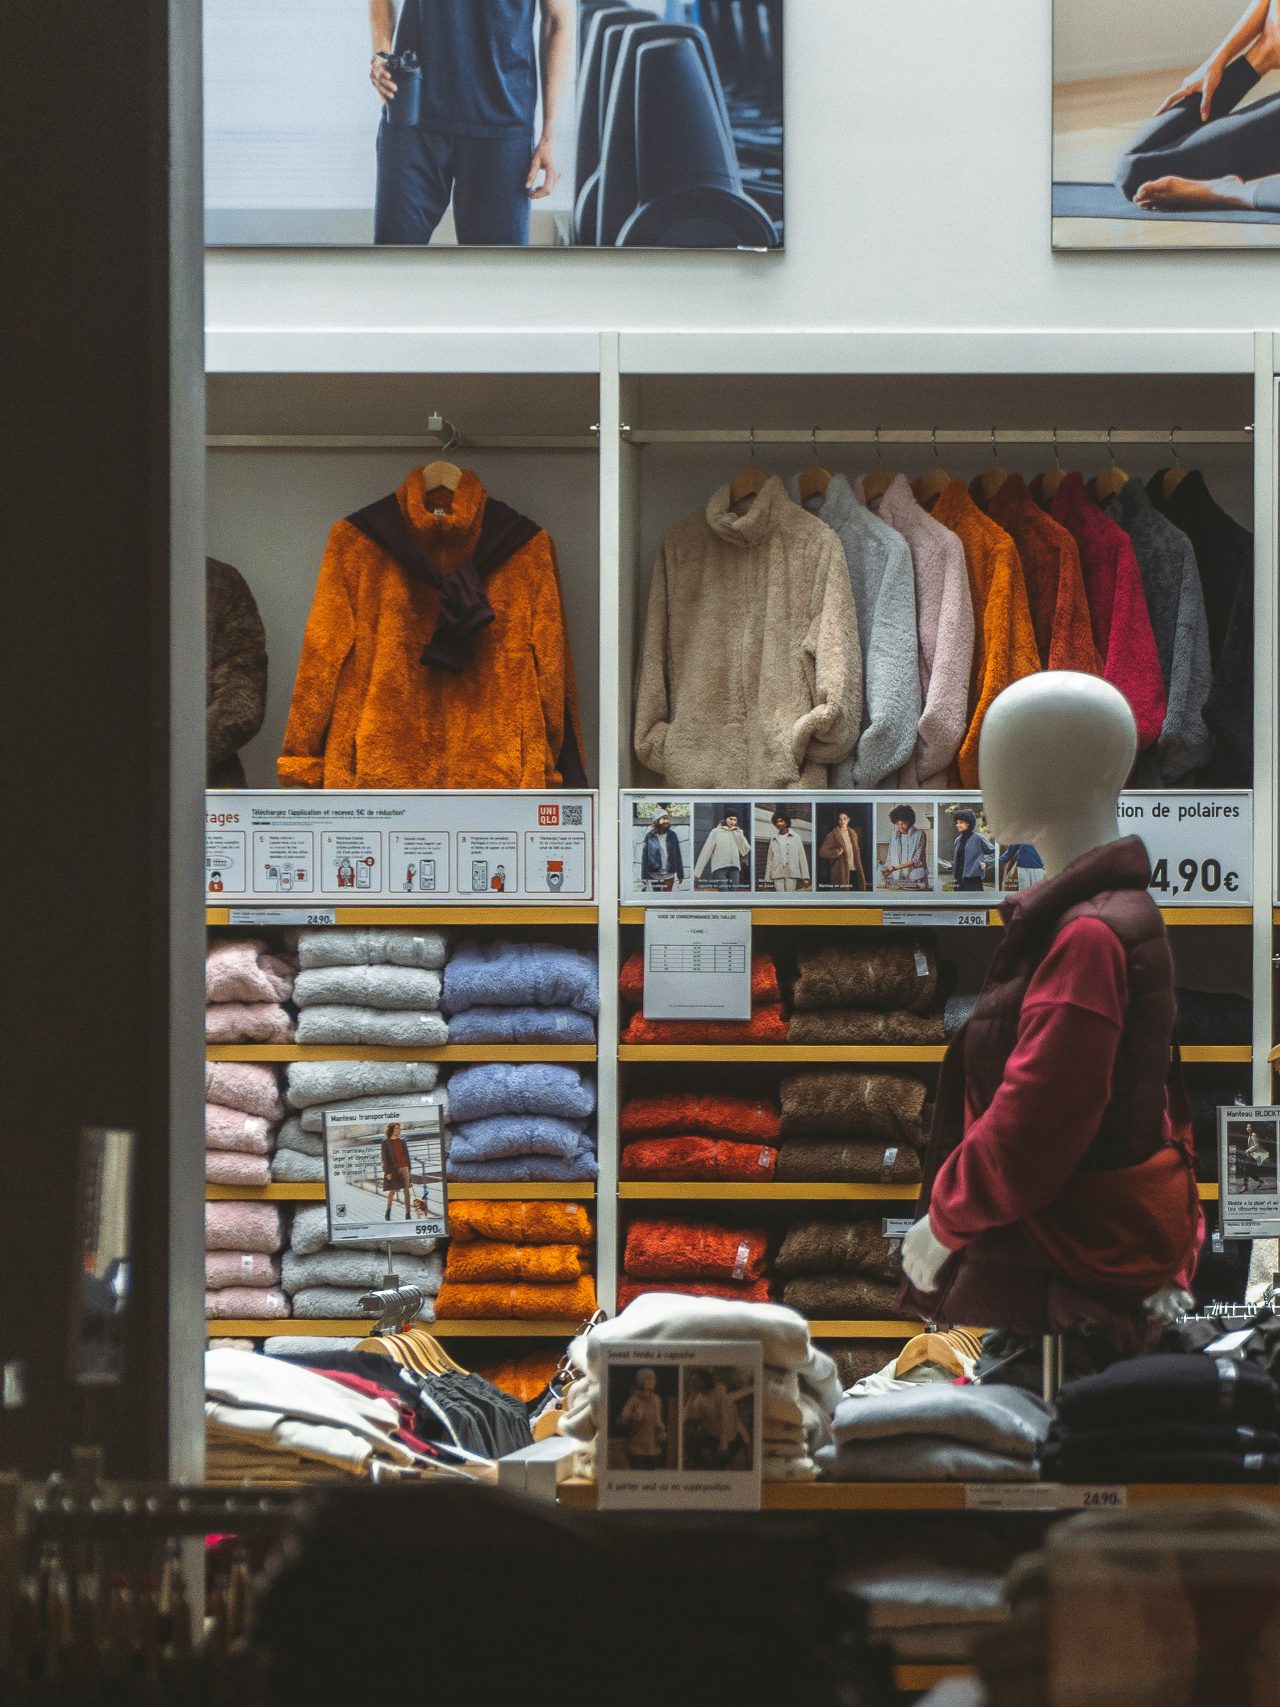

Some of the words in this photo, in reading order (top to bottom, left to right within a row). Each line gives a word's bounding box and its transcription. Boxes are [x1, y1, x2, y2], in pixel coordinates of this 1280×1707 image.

[540, 807, 556, 815] UNI
[1152, 802, 1170, 818] de
[1178, 802, 1240, 821] polaires
[540, 815, 557, 825] QLO
[330, 1114, 357, 1122] Manteau
[358, 1111, 400, 1122] transportable
[1226, 1110, 1253, 1118] Manteau
